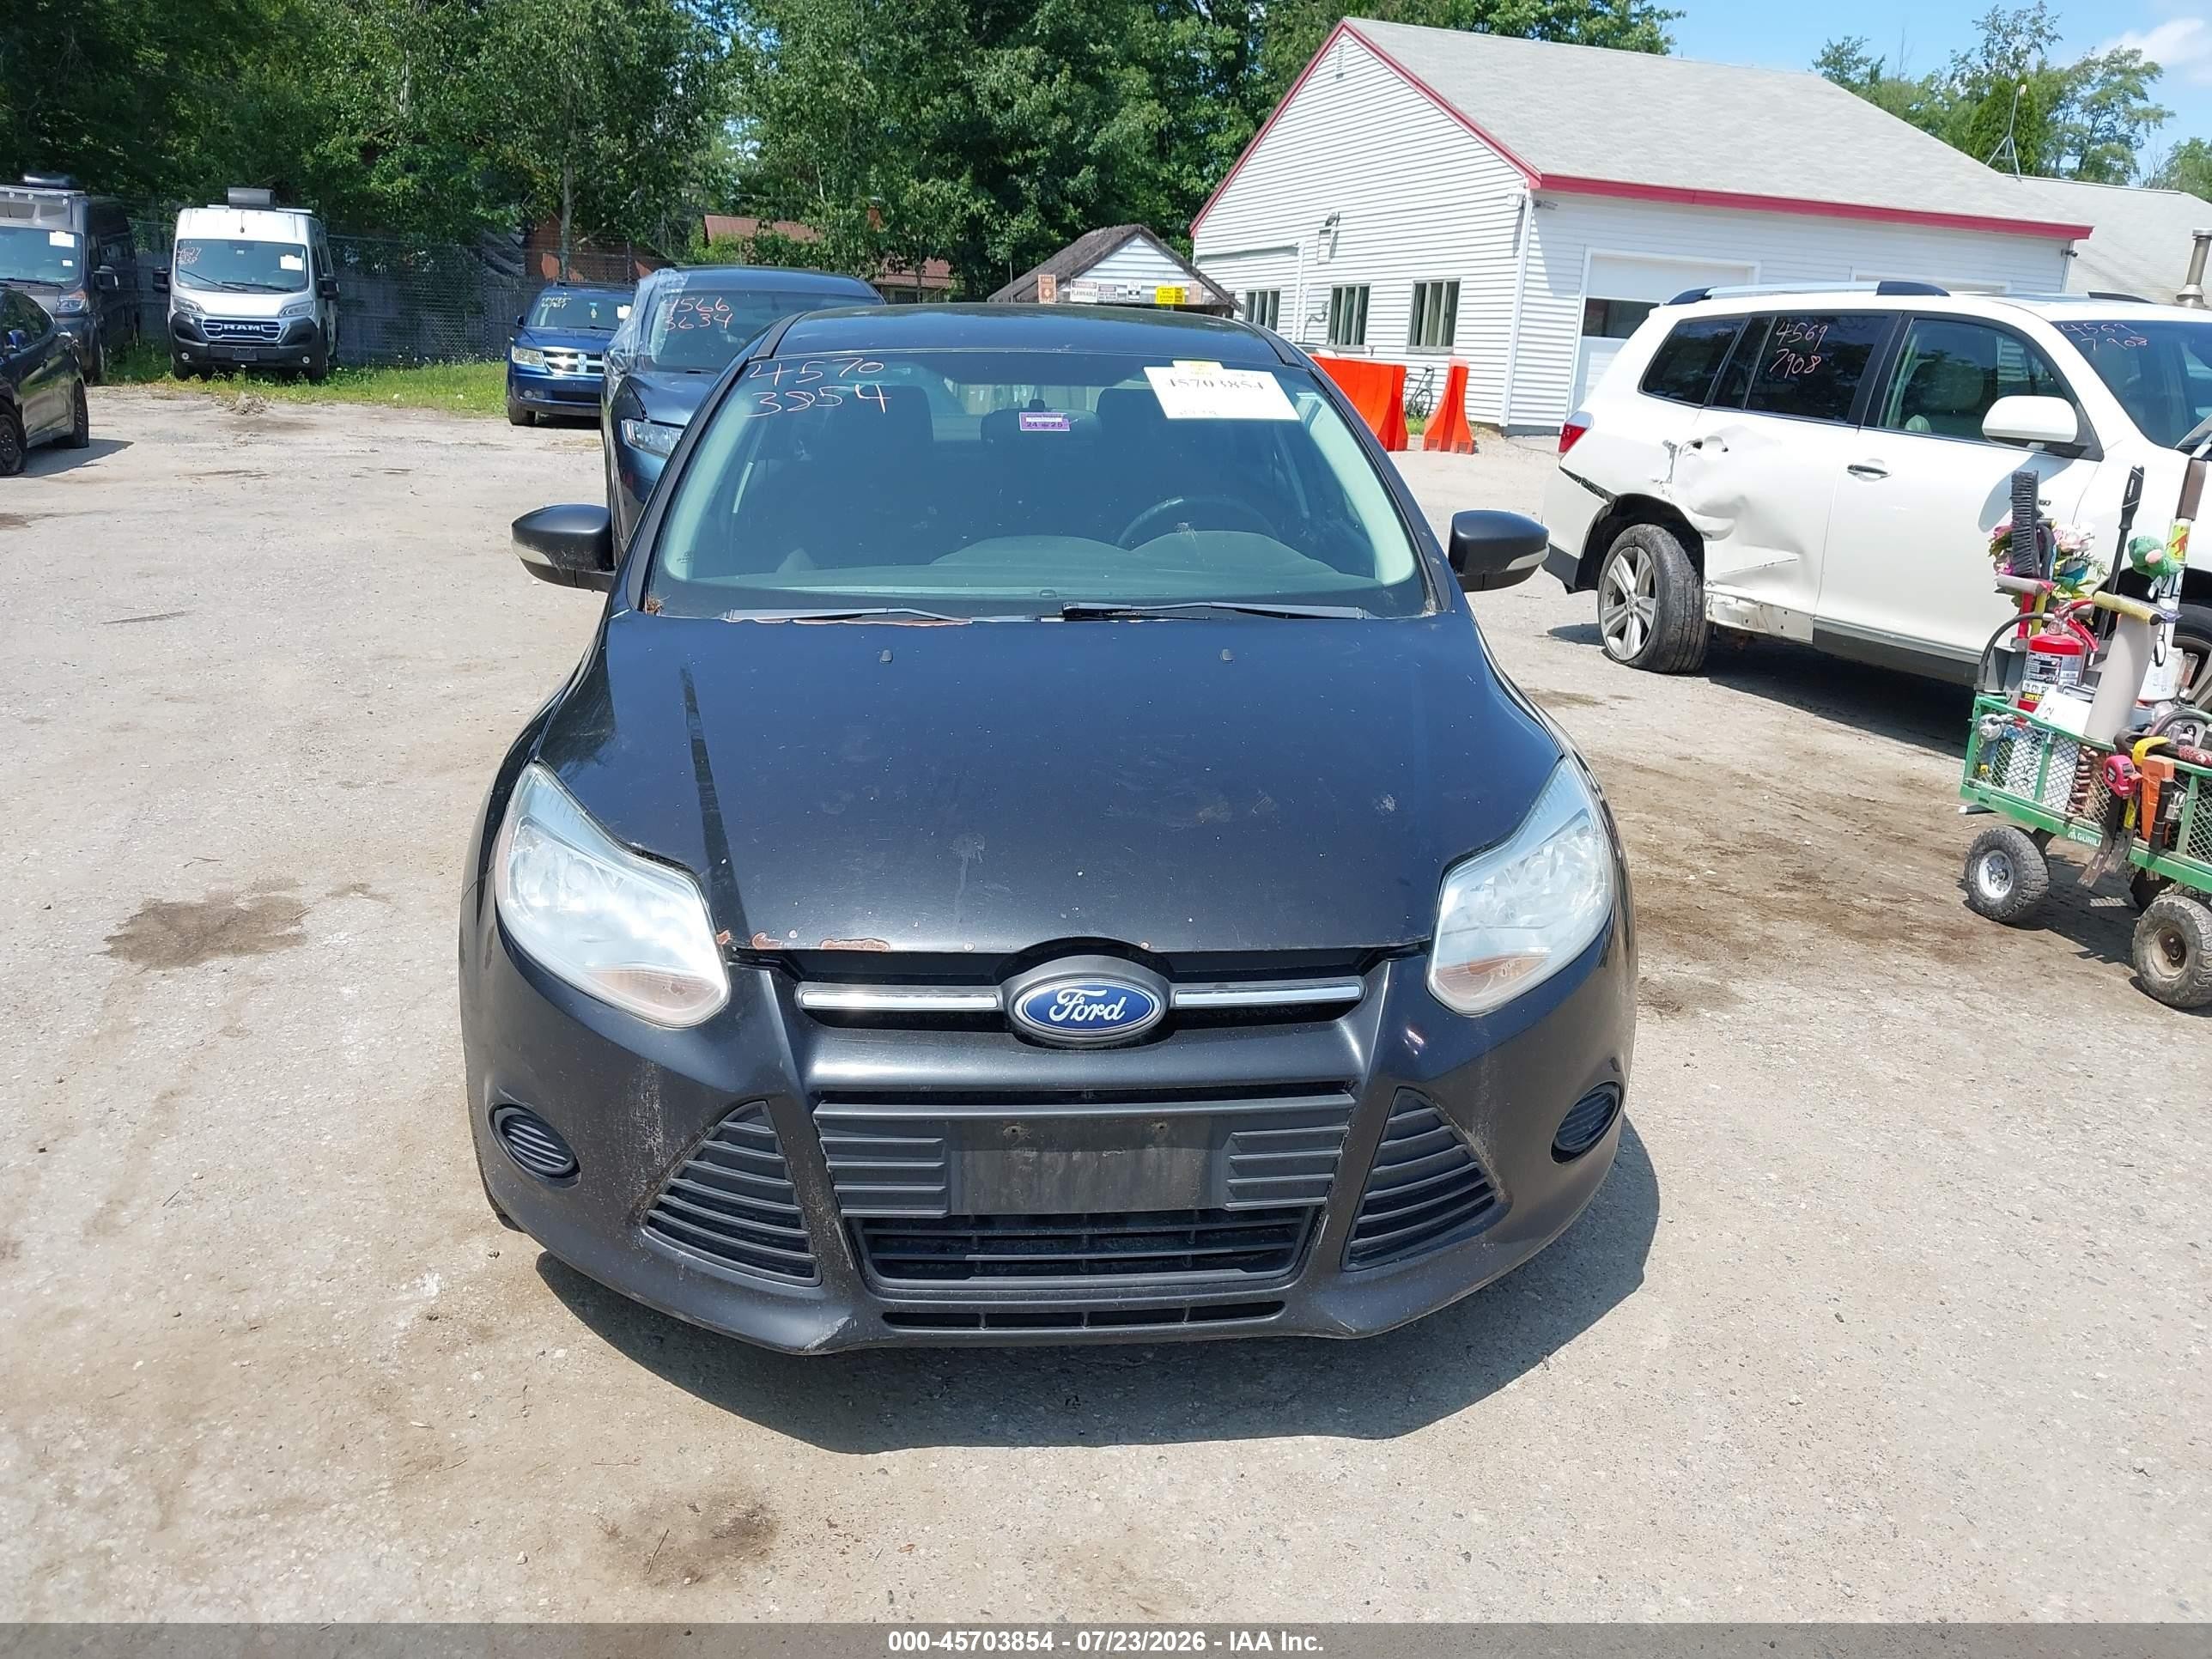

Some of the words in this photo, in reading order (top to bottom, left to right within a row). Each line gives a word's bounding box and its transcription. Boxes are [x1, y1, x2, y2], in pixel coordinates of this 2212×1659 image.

[662, 297, 730, 316] 4566
[662, 313, 733, 331] 3634
[1776, 321, 1828, 352] 4569
[2081, 336, 2148, 351] 7908
[749, 357, 884, 386] 4570
[1769, 348, 1822, 379] 7908
[742, 383, 892, 417] 3854
[1048, 988, 1127, 1022] Ford
